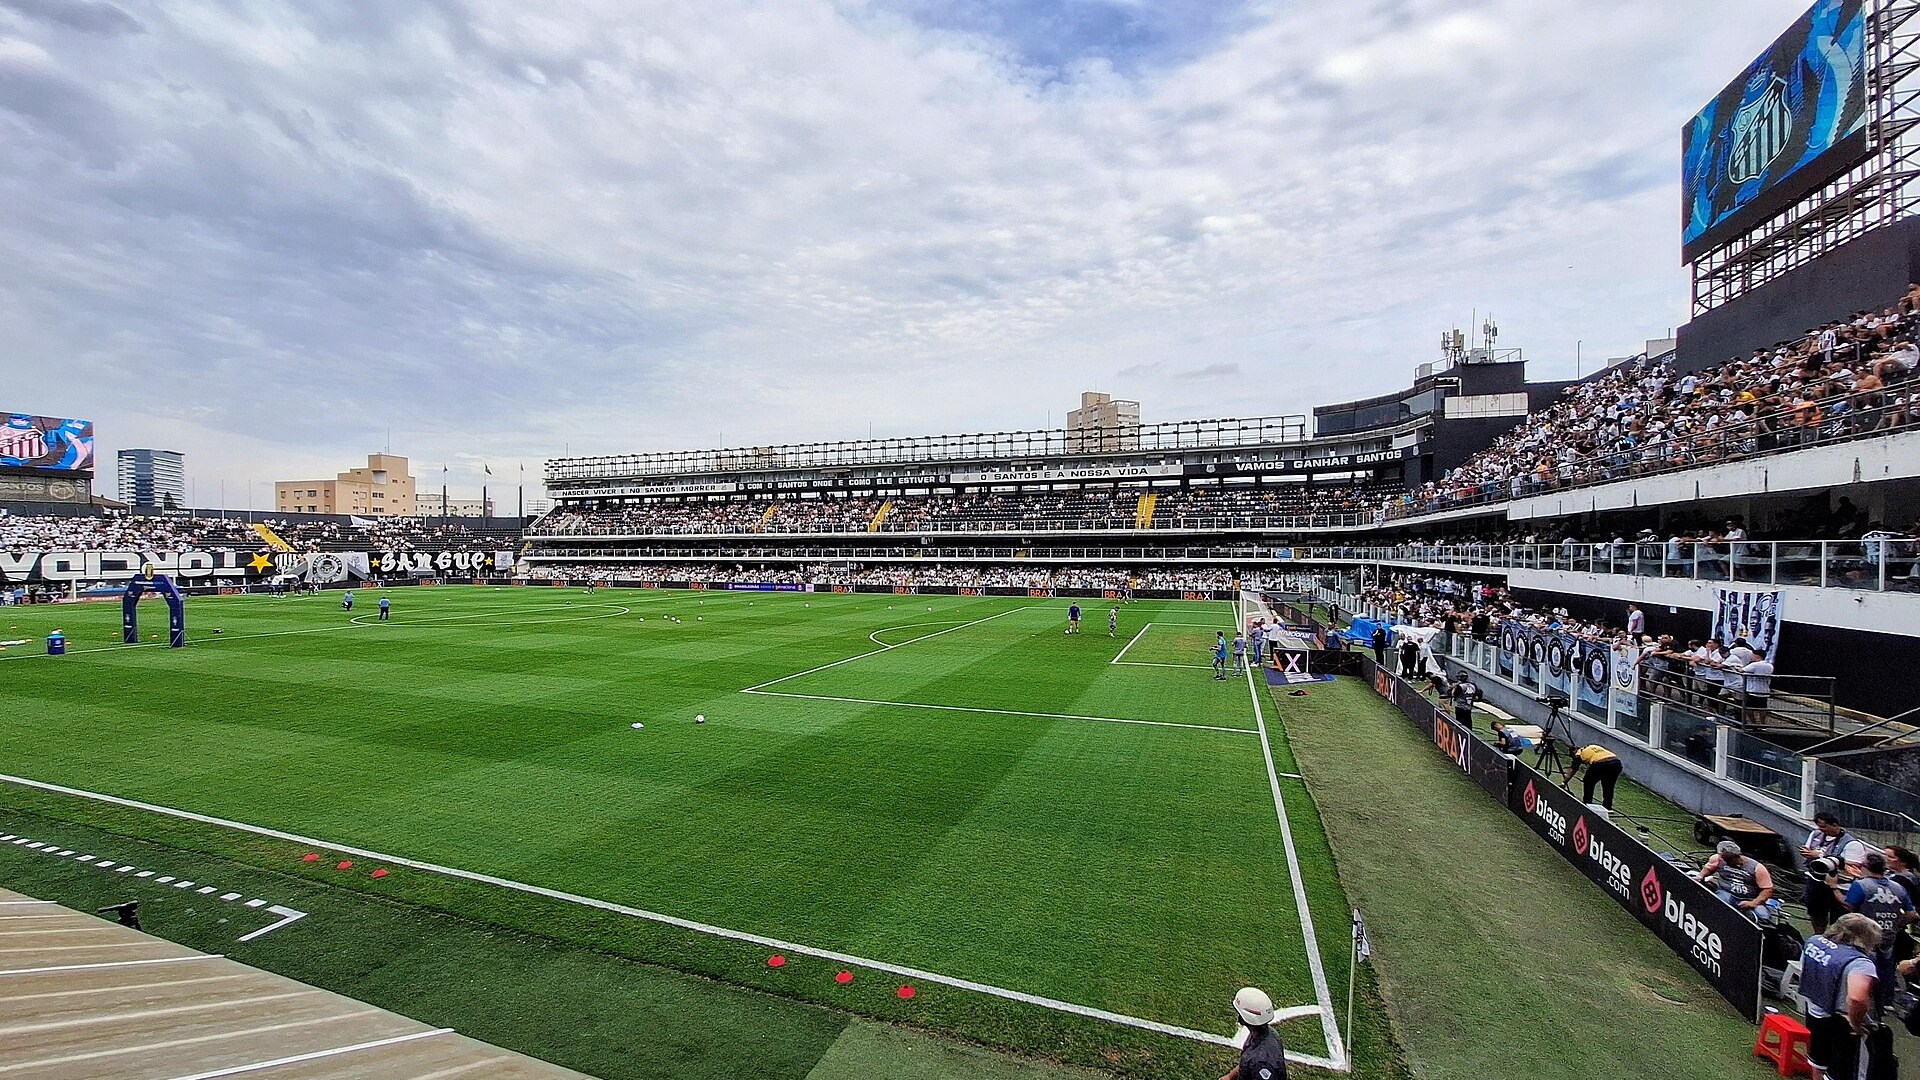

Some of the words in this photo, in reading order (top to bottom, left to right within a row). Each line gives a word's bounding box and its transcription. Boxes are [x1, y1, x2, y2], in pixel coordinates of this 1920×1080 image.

[1236, 461, 1285, 471] VAMOS
[1293, 457, 1349, 469] GANHAR
[1356, 450, 1402, 463] SANTOS
[747, 482, 763, 490] COM
[813, 479, 833, 487] ONDE
[849, 478, 871, 486] COMO
[876, 477, 893, 485] ELE
[898, 475, 936, 484] ESTIVER
[994, 472, 1038, 480] SANTOS
[1070, 469, 1111, 477] NOSSA
[1118, 468, 1148, 476] VIDA
[681, 484, 716, 492] MORRER
[220, 587, 247, 595] BRAX
[960, 587, 983, 596] BRAX
[1030, 589, 1053, 598] BRAX
[1104, 590, 1129, 599] BRAX
[1183, 592, 1210, 600] BRAX
[1377, 670, 1394, 704] BRAX
[1437, 717, 1467, 771] BRAX
[1536, 795, 1566, 834] blaze
[1548, 828, 1565, 846] .com
[1589, 834, 1631, 885] blaze
[1607, 875, 1630, 900] .com
[1665, 890, 1722, 960] blaze
[1690, 945, 1721, 977] .com
